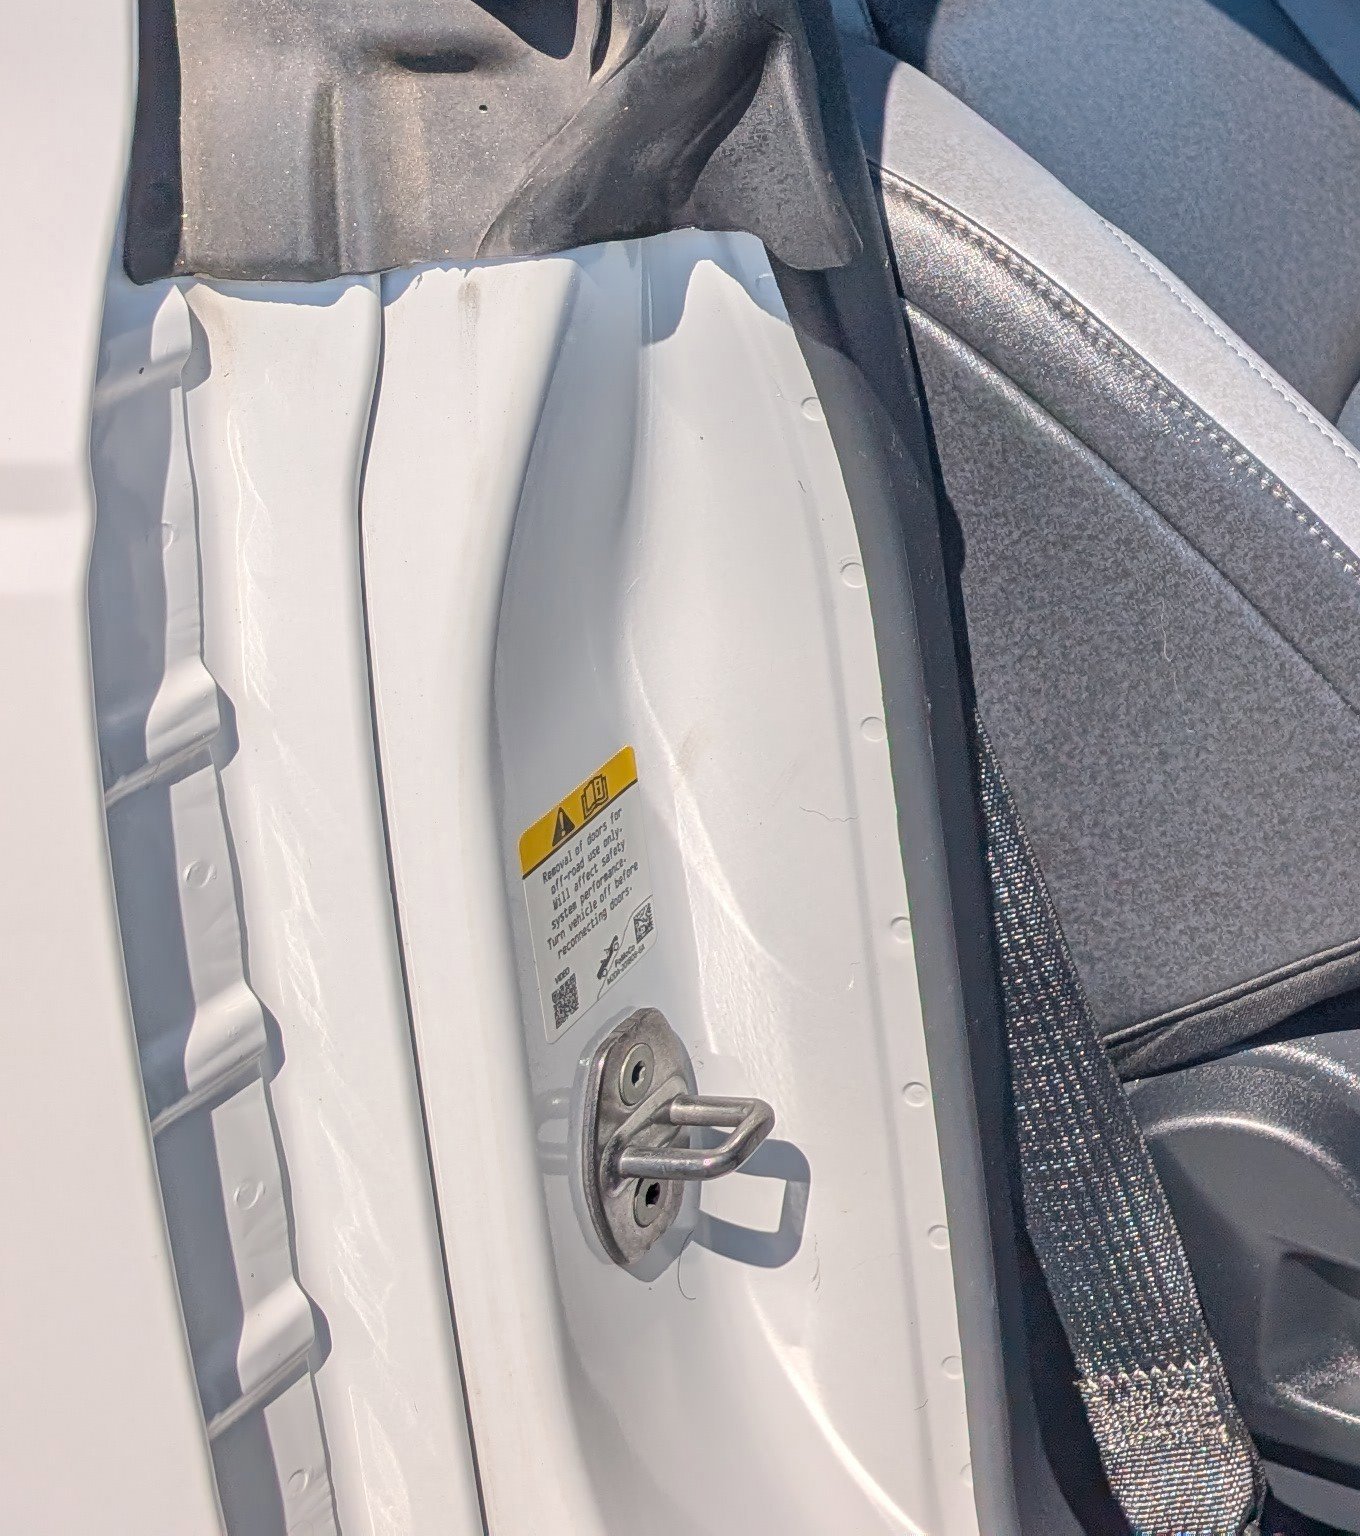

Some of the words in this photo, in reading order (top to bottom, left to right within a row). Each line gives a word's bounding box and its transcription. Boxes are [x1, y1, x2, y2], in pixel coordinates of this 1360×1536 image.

[542, 850, 573, 884] Removal
[574, 840, 583, 856] of
[586, 822, 608, 845] doors
[610, 808, 622, 824] for
[550, 857, 585, 894] off-road
[587, 845, 600, 862] use
[603, 828, 623, 847] only.
[552, 887, 570, 910] Will
[574, 863, 598, 892] affect
[601, 839, 625, 867] safety
[547, 930, 566, 950] Turn
[568, 900, 597, 931] vehicle
[599, 883, 611, 903] off
[614, 861, 639, 889] before
[551, 901, 577, 930] system
[579, 858, 626, 906] performance.
[557, 908, 607, 959] reconnecting
[610, 887, 632, 910] doors.
